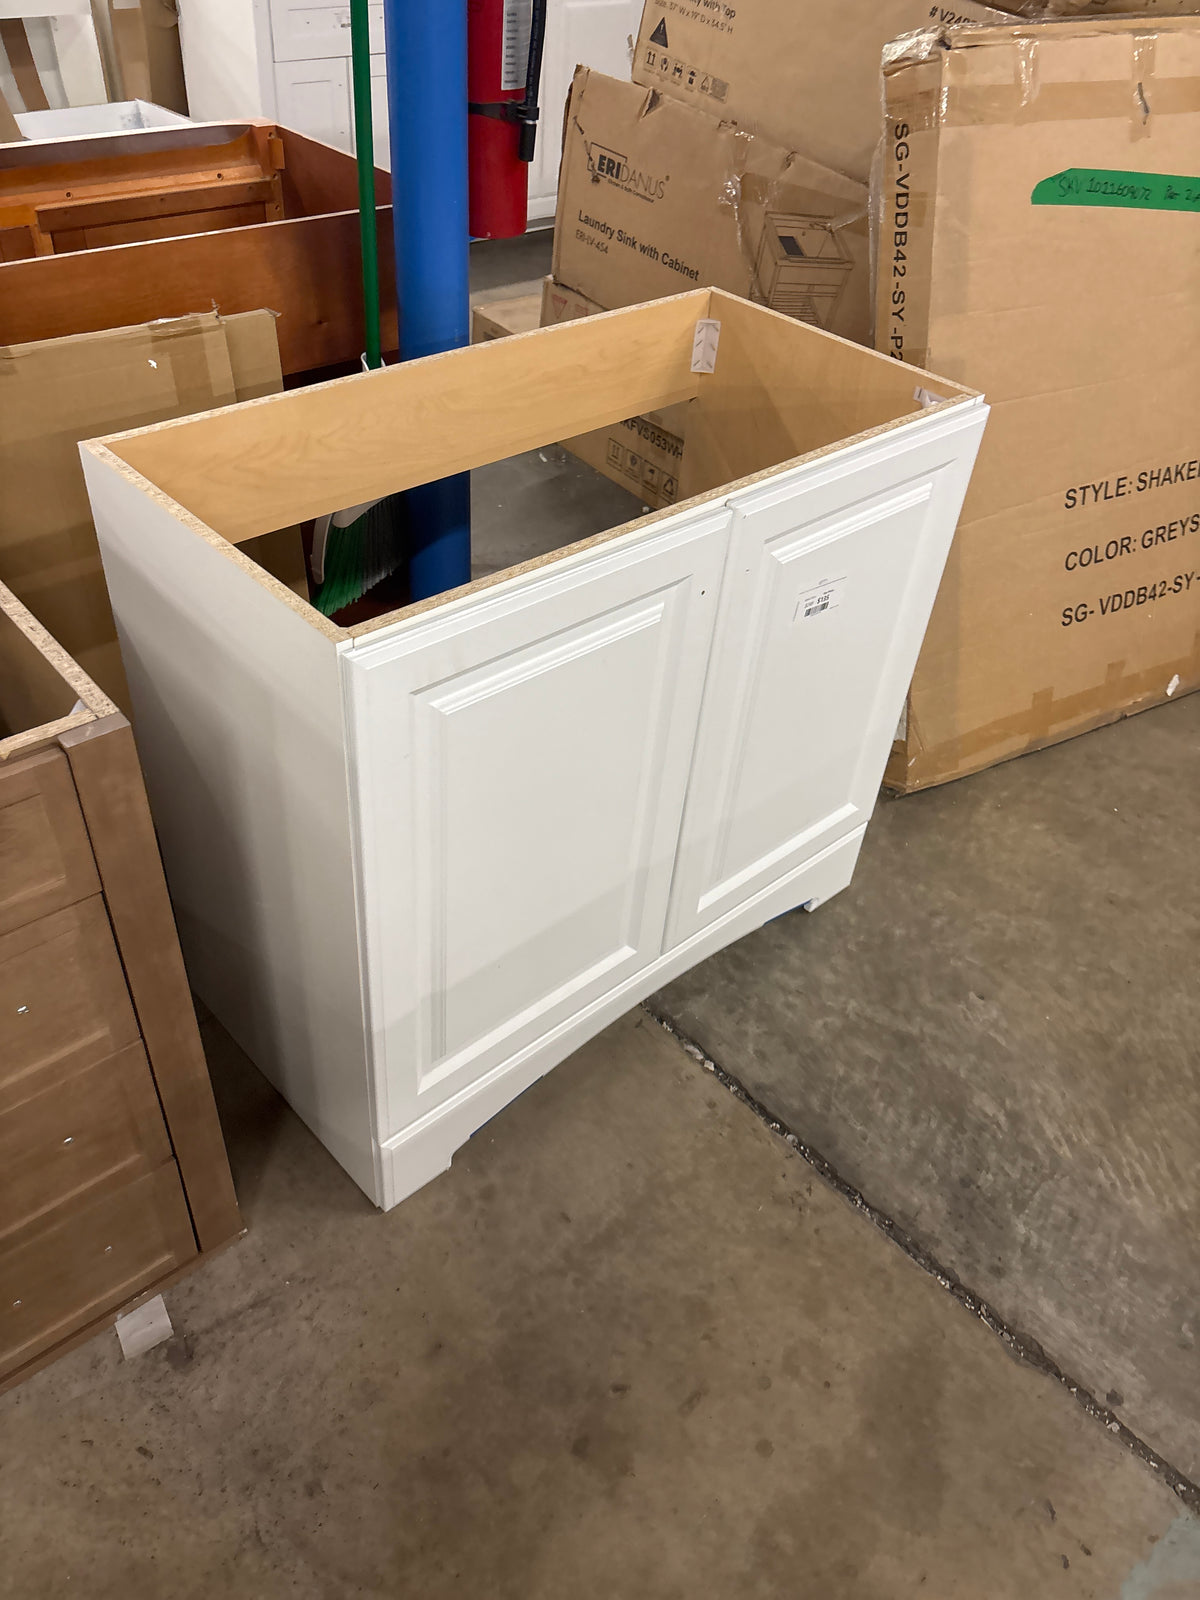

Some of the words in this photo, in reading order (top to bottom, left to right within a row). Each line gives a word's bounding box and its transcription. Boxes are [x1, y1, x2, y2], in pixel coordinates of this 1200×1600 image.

[578, 209, 615, 240] Laundry
[616, 229, 638, 250] Sink
[639, 243, 659, 261] with
[661, 252, 700, 281] Cabinet
[1065, 476, 1133, 509] STYLE:
[1136, 460, 1200, 492] SHAKE
[1065, 535, 1137, 571] COLOR:
